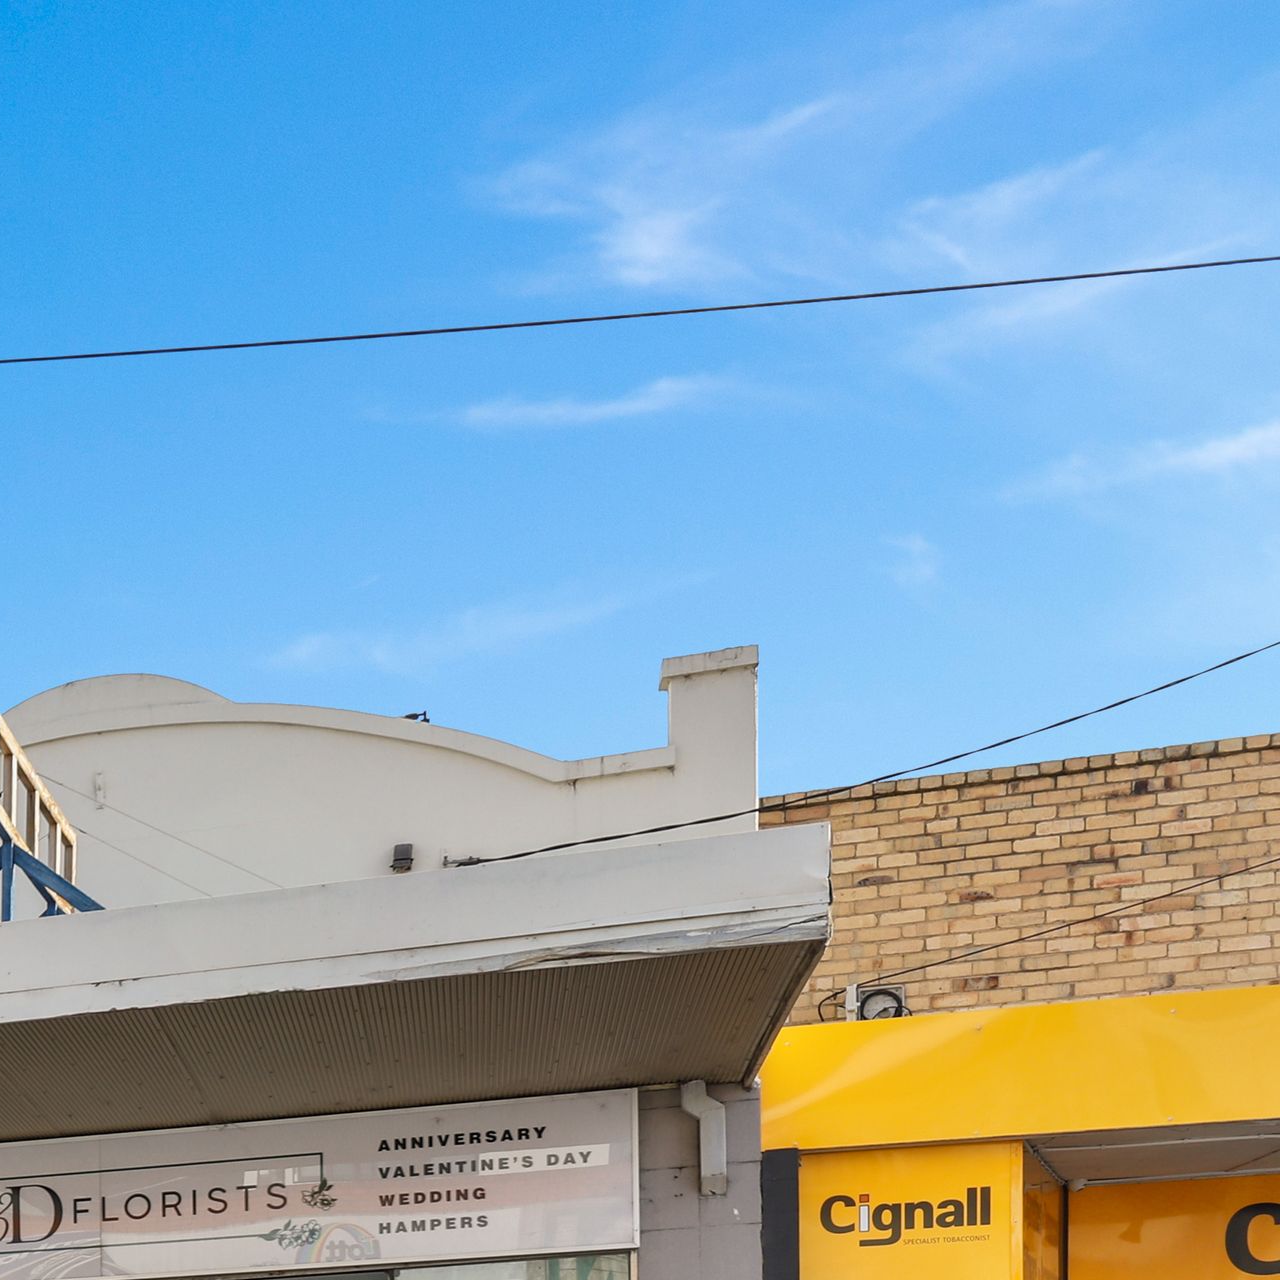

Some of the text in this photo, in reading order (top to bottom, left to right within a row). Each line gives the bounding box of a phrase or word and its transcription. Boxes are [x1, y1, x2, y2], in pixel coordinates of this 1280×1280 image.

[378, 1126, 546, 1152] ANNIVERSARY
[378, 1150, 592, 1179] VALENTINE'S DAY
[73, 1182, 288, 1224] FLORISTS
[379, 1187, 487, 1207] WEDDING
[379, 1215, 489, 1235] HAMPERS
[820, 1186, 991, 1247] Cignall
[903, 1234, 990, 1245] SPECIALIST TOBACCONIST
